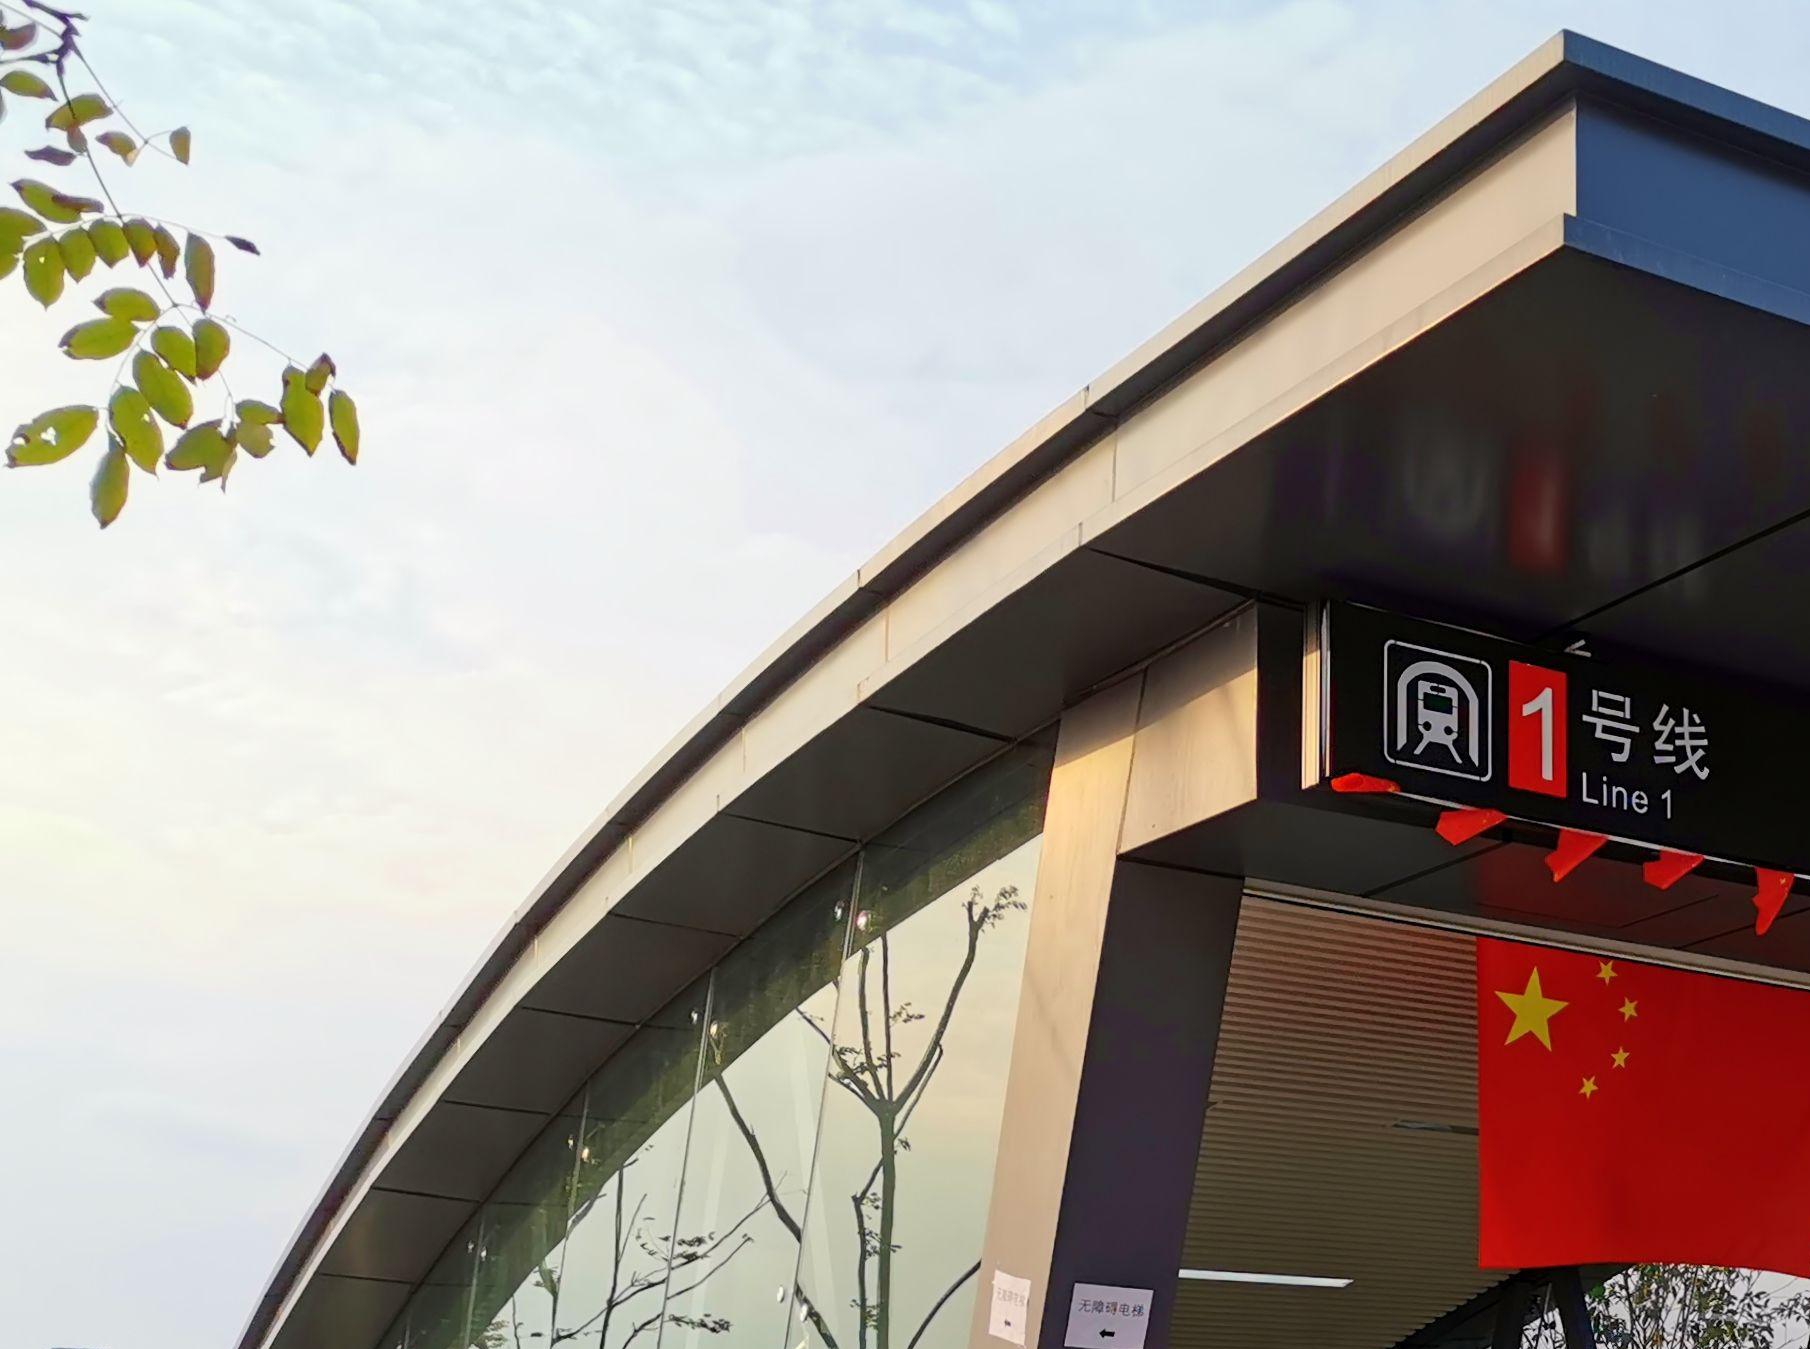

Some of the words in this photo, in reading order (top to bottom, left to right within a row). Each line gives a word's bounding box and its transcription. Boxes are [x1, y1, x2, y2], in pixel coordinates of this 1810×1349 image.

[1582, 772, 1648, 814] Line
[1661, 790, 1672, 819] 1
[1077, 1299, 1145, 1318] 无障碍电梯
